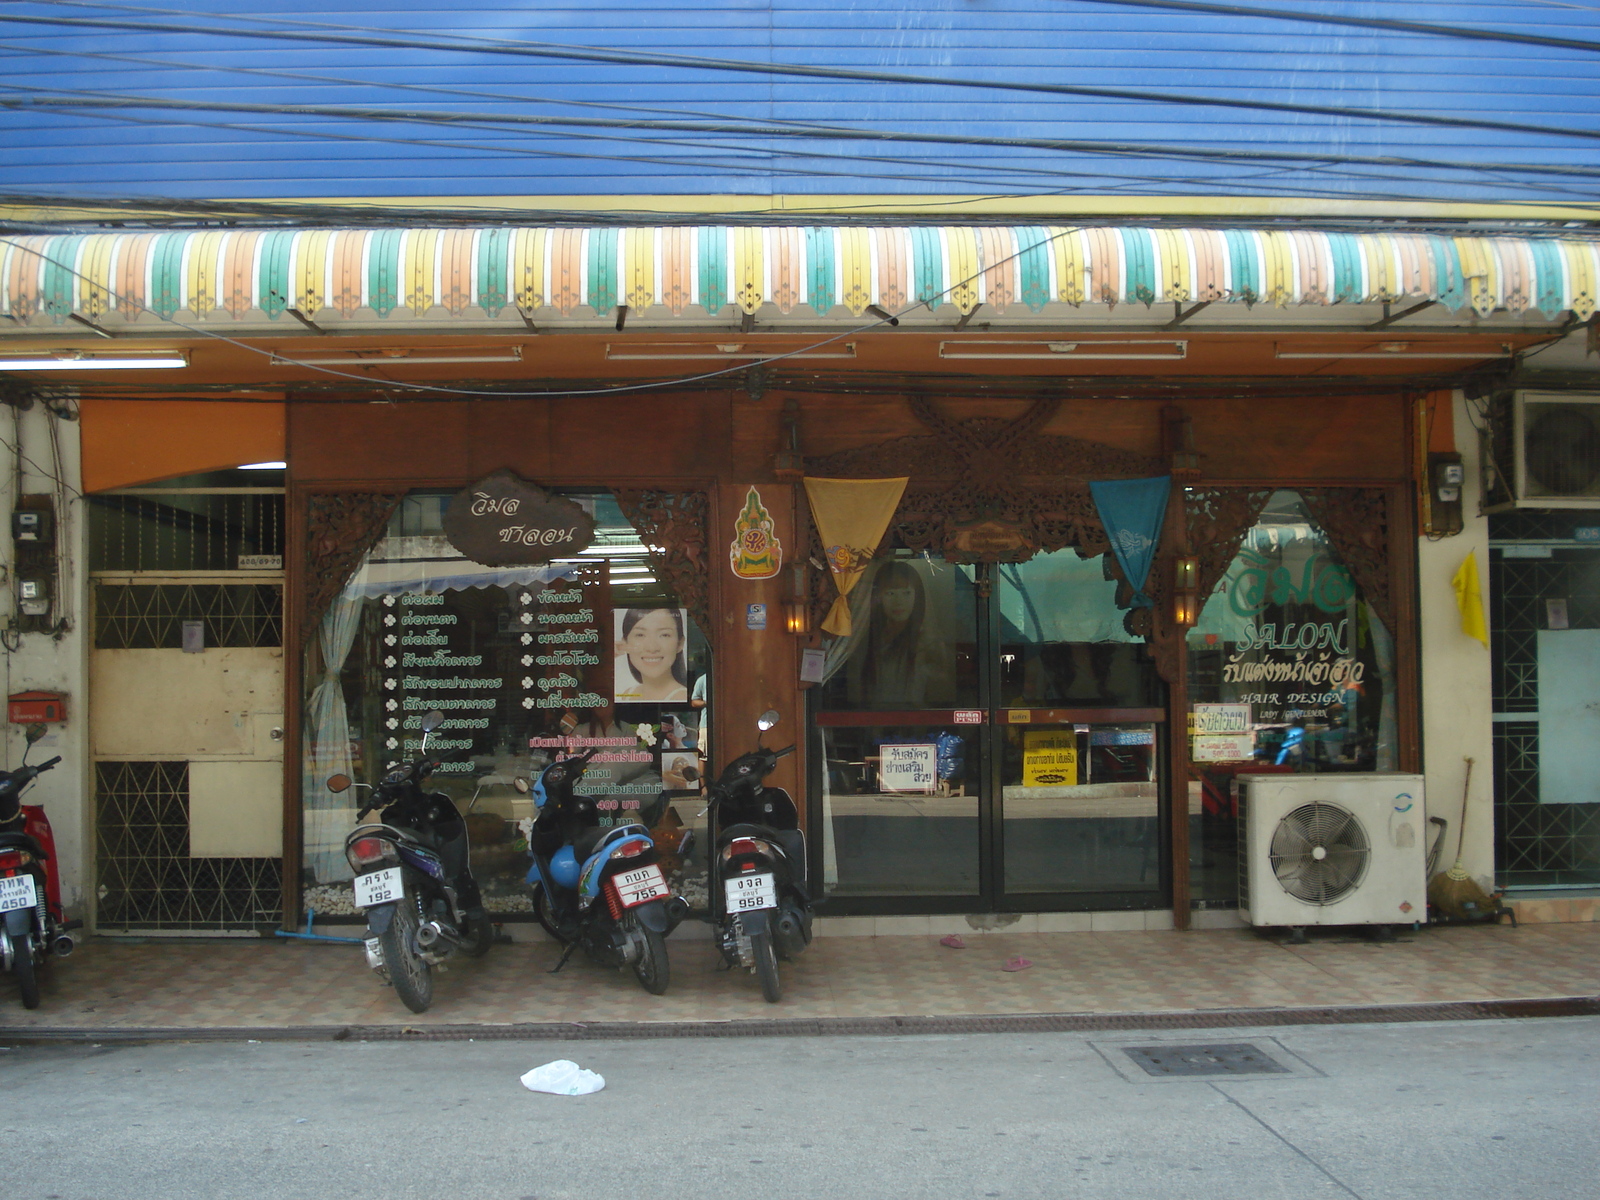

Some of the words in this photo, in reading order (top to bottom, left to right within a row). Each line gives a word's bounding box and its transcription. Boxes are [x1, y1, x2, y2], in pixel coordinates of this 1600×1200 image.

[471, 491, 520, 516] วิมล
[499, 524, 577, 546] ซาลอน
[1230, 547, 1356, 618] วิมล
[402, 591, 444, 605] ต่อผม
[537, 589, 582, 603] ขัดหน้า
[401, 611, 457, 625] ต่อขนตา
[538, 609, 593, 624] นวดหน้า
[1236, 618, 1349, 654] SALON
[1223, 651, 1365, 685] รับแต่งหน้าเจ้าสาว
[402, 675, 502, 689] สักขอบปากถาวร
[402, 696, 497, 710] สักขอบตาถาวร
[536, 689, 609, 709] เปลี่ยนสีผิว
[1240, 693, 1282, 705] HAIR
[1287, 692, 1346, 706] DESIGN
[891, 747, 928, 760] รับสมัคร
[913, 773, 931, 783] สวย
[596, 799, 618, 810] 400
[621, 799, 640, 810] บาท
[368, 890, 392, 903] 192
[632, 888, 657, 901] 755
[1, 897, 27, 910] 450
[739, 896, 764, 908] 958
